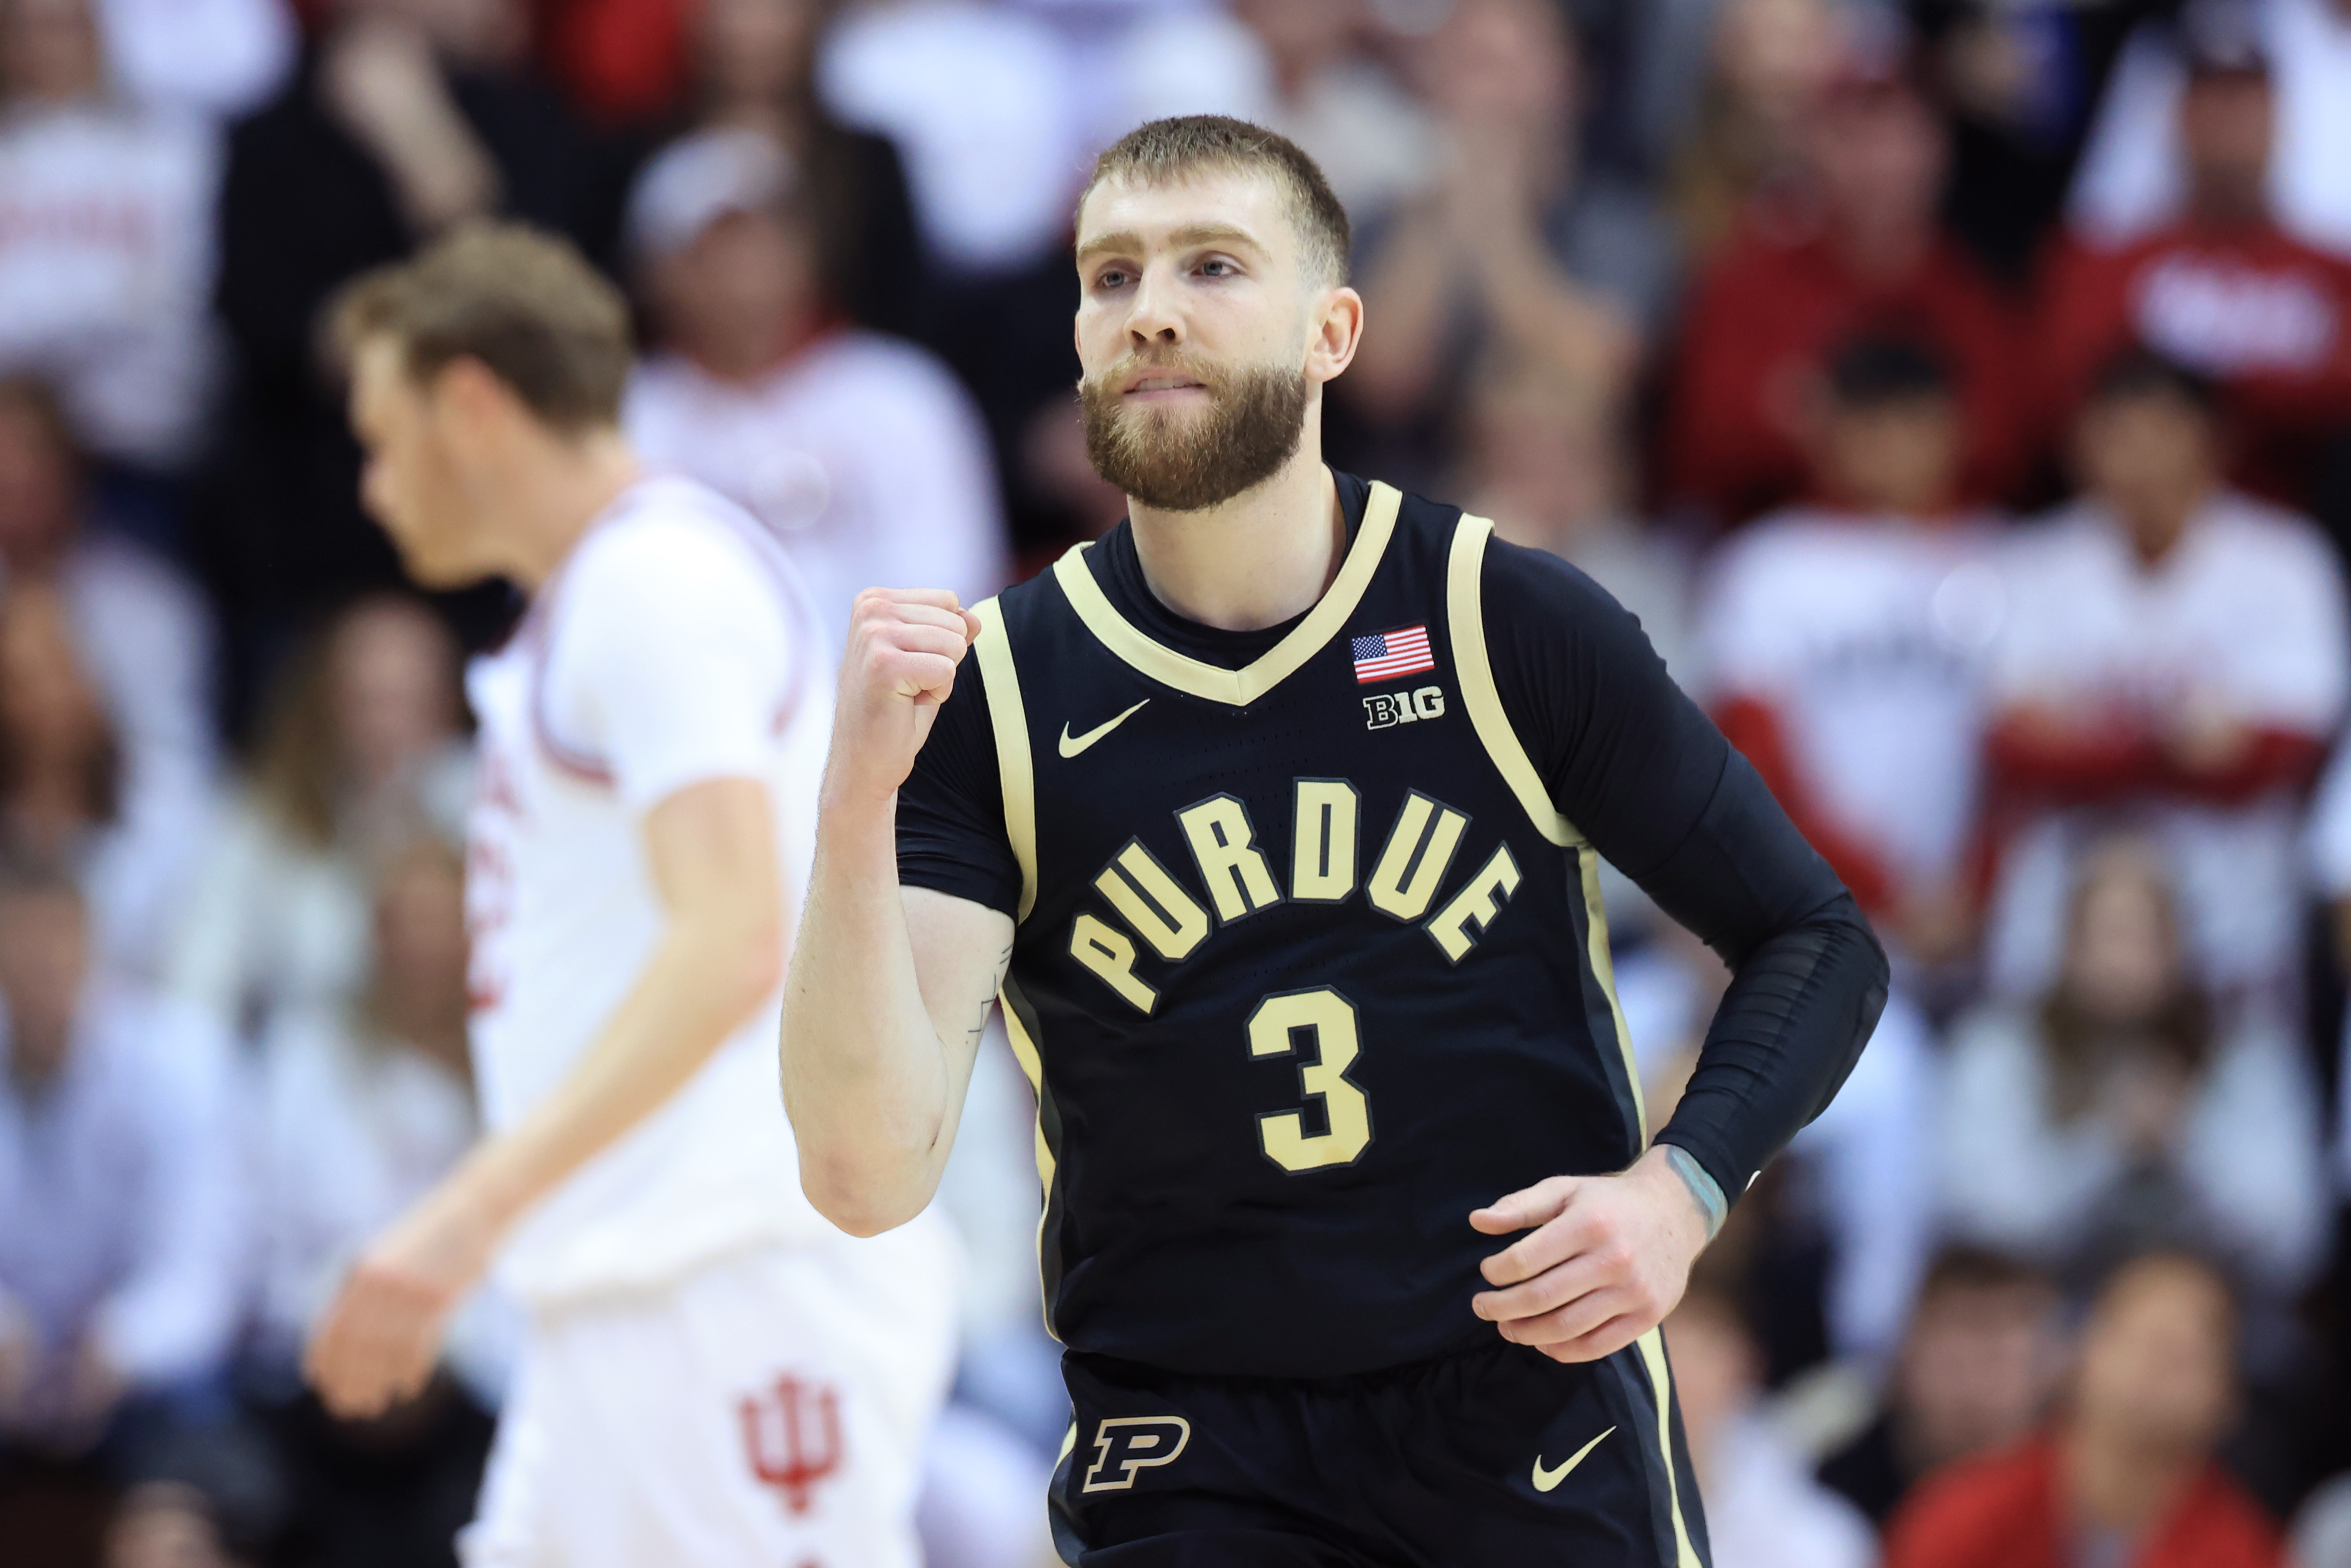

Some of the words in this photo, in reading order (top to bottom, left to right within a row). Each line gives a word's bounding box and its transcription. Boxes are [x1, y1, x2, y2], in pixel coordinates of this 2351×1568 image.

[1067, 777, 1523, 1016] PURDUE
[1244, 985, 1375, 1176] 3
[1082, 1416, 1190, 1493] P
